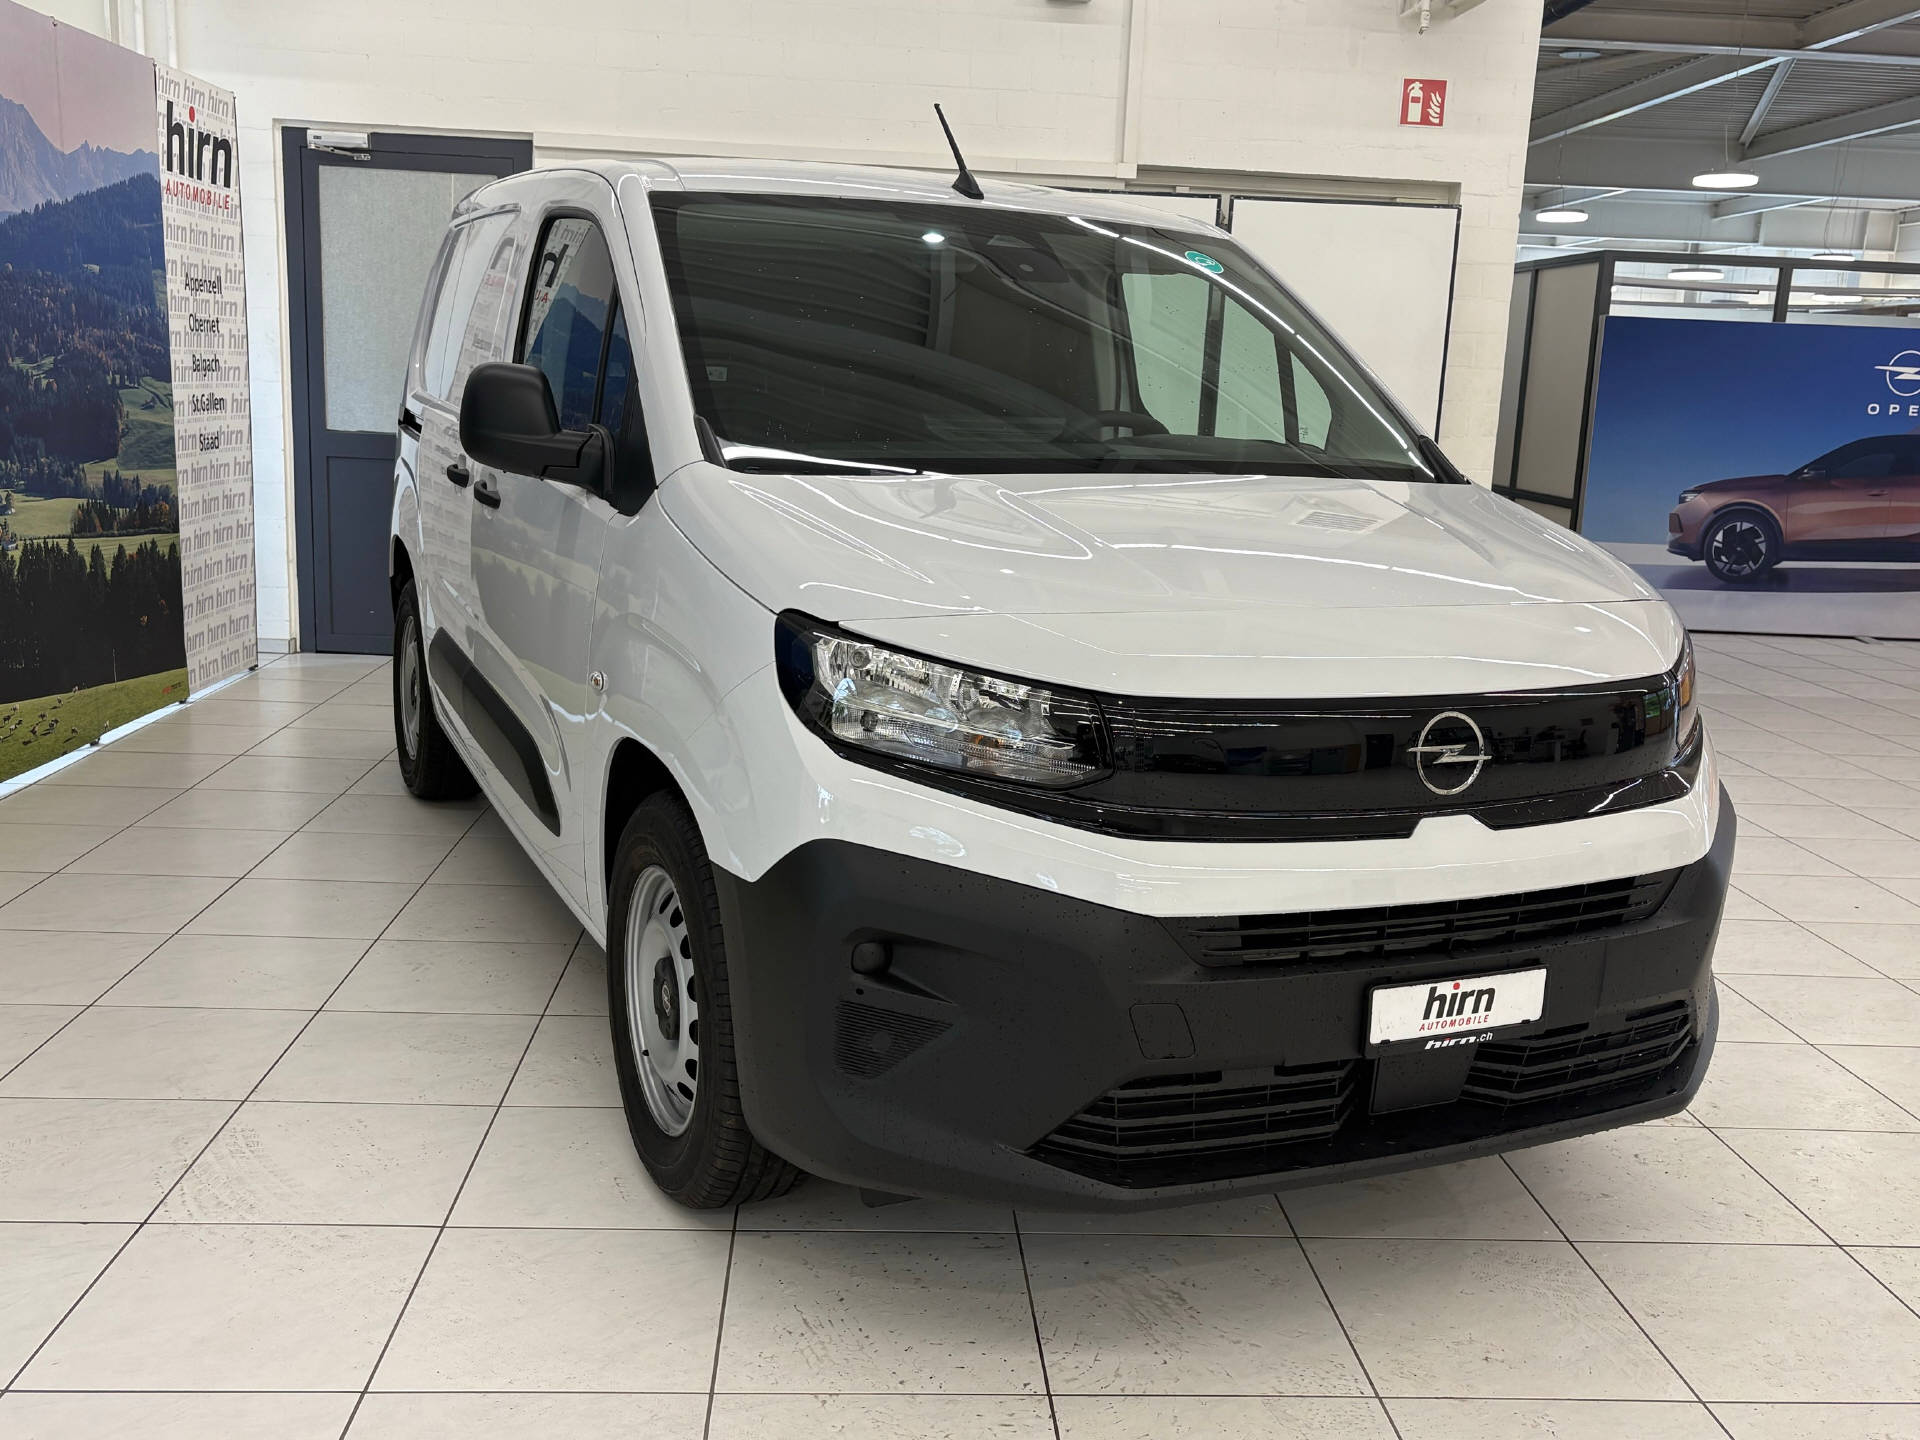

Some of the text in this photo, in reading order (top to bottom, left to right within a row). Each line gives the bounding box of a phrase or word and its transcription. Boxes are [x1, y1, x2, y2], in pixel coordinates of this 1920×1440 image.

[184, 78, 205, 108] hirn
[208, 89, 228, 118] hirn
[167, 100, 232, 188] hirn
[166, 179, 230, 209] AUTOMOBILE
[166, 217, 187, 245] hirn
[190, 222, 208, 247] hirn
[210, 226, 234, 252] hirn
[184, 272, 222, 297] Appenzell
[192, 353, 220, 377] Balgach
[199, 431, 219, 451] Staad
[210, 458, 230, 480] hirn
[202, 492, 219, 515] hirn
[222, 488, 245, 510] hirn
[213, 522, 232, 544] hirn
[204, 556, 222, 580] hirn
[225, 552, 248, 573] hirn
[216, 585, 236, 608] hirn
[221, 648, 240, 672] hirn
[1422, 982, 1496, 1020] hirn
[1419, 1014, 1490, 1032] AUTOMOBILE
[1424, 1031, 1494, 1050] hirn.ch
